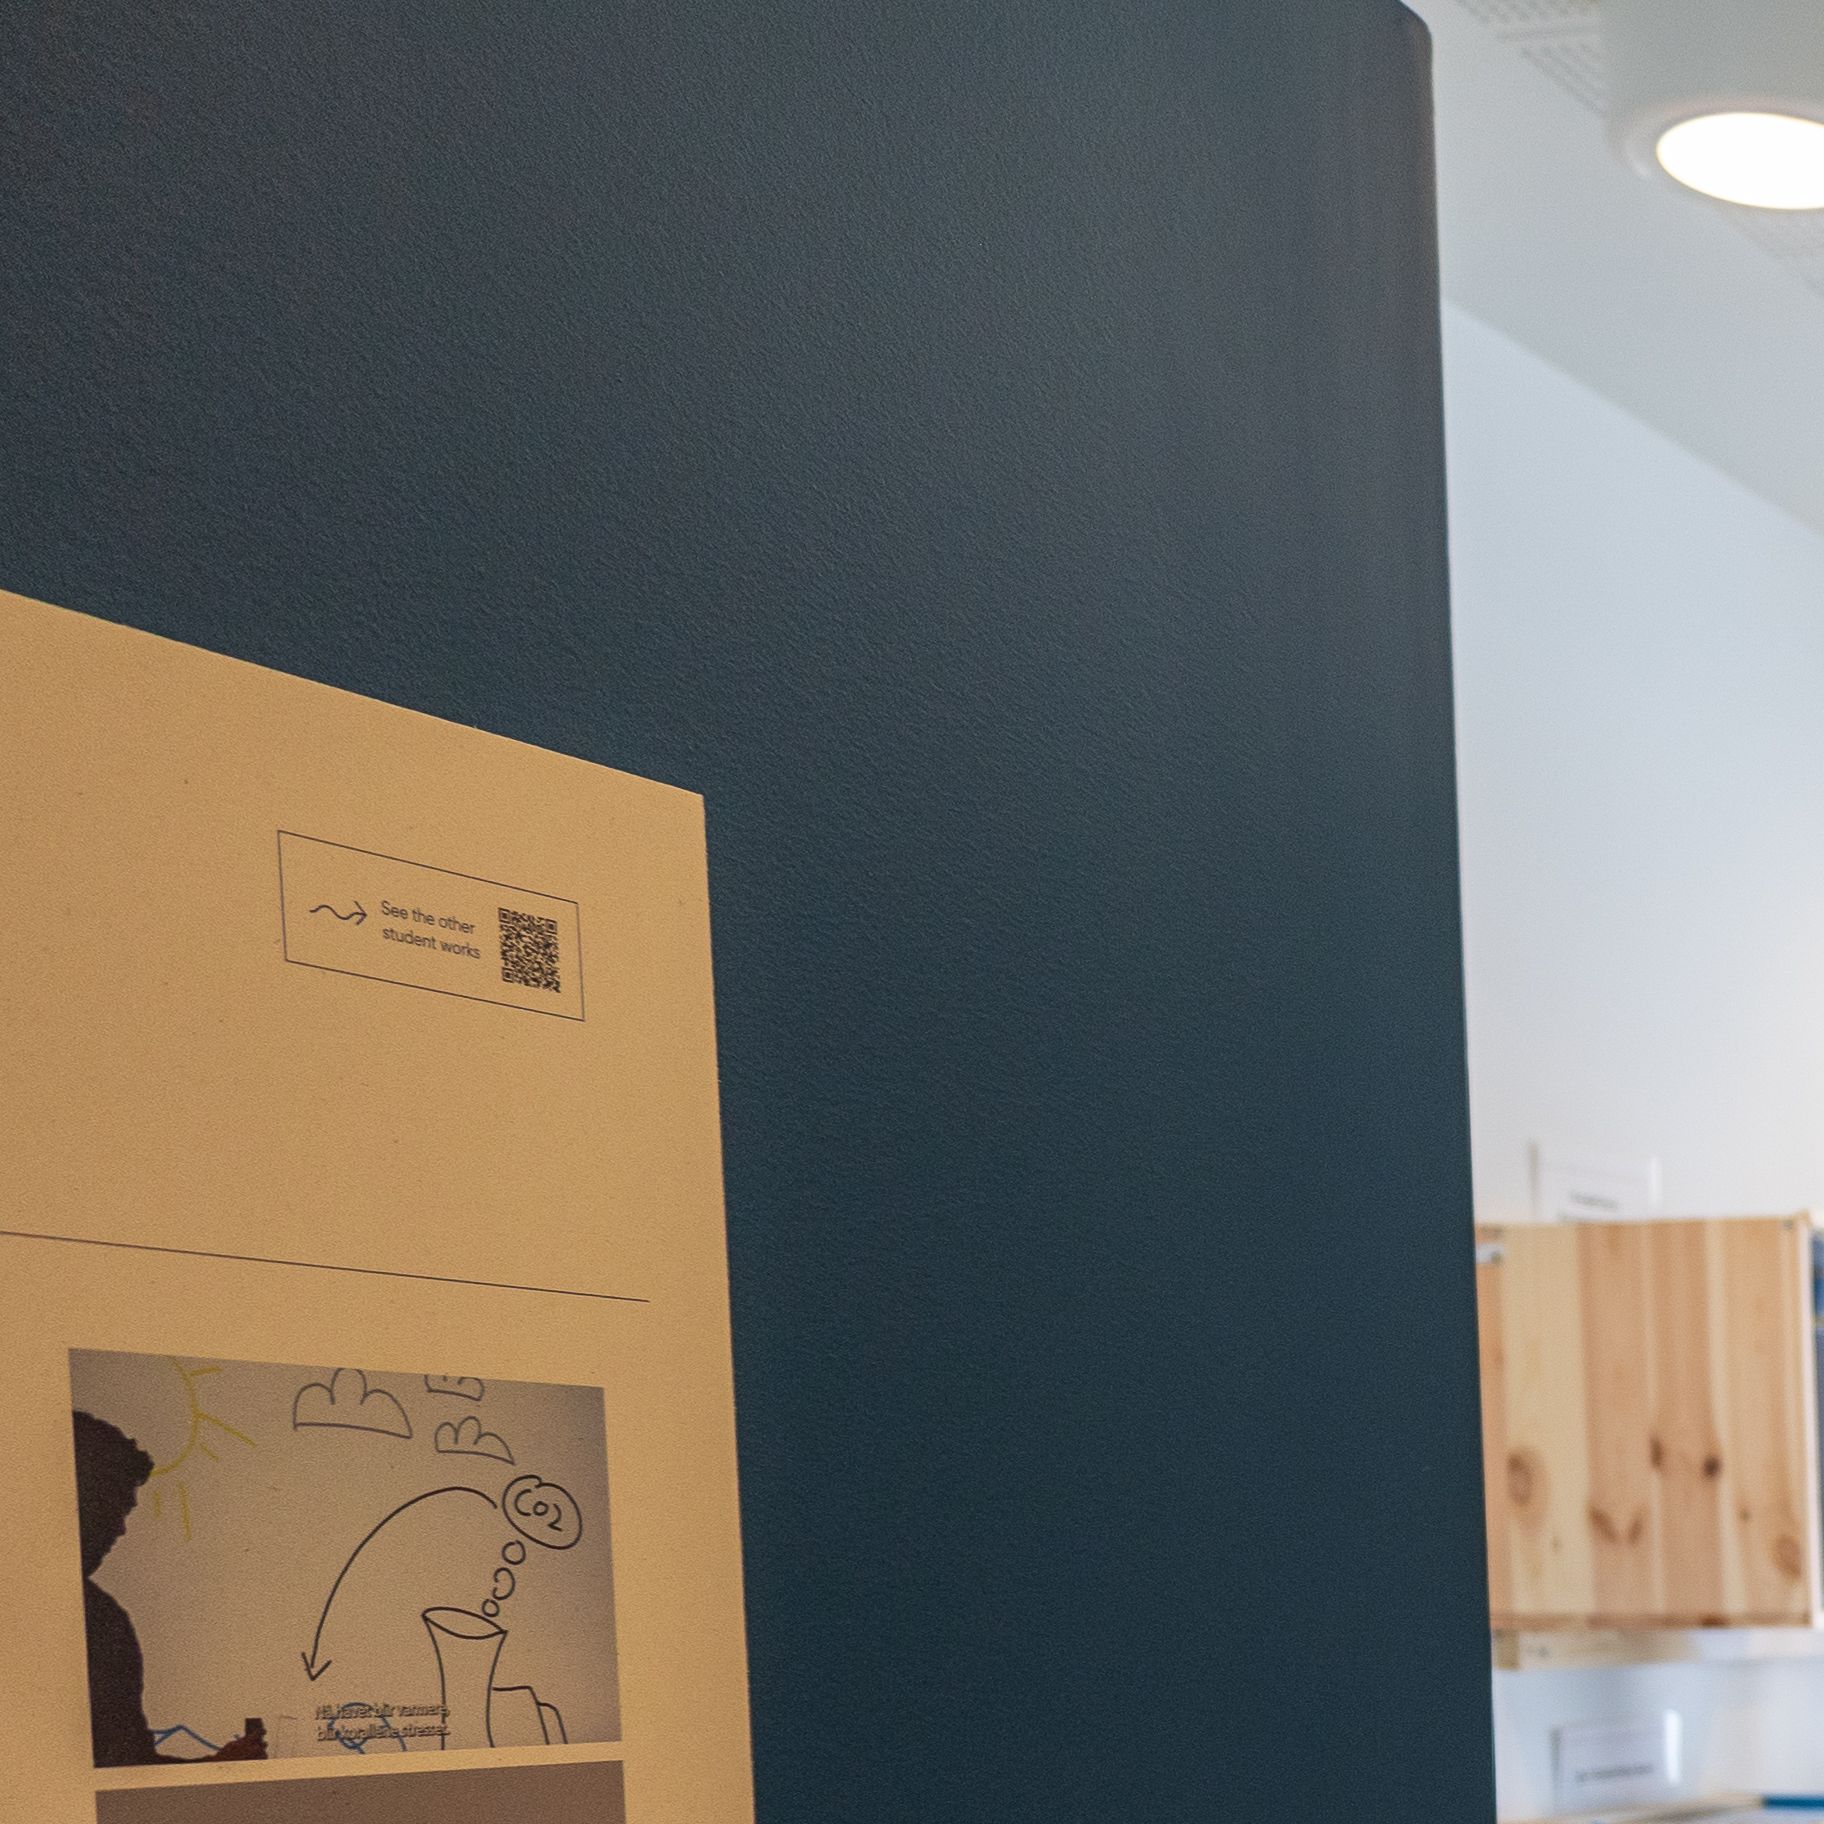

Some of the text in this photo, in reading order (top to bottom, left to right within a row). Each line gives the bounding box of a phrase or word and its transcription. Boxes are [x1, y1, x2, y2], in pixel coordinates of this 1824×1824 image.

[381, 900, 476, 934] See the other
[382, 927, 481, 960] student works
